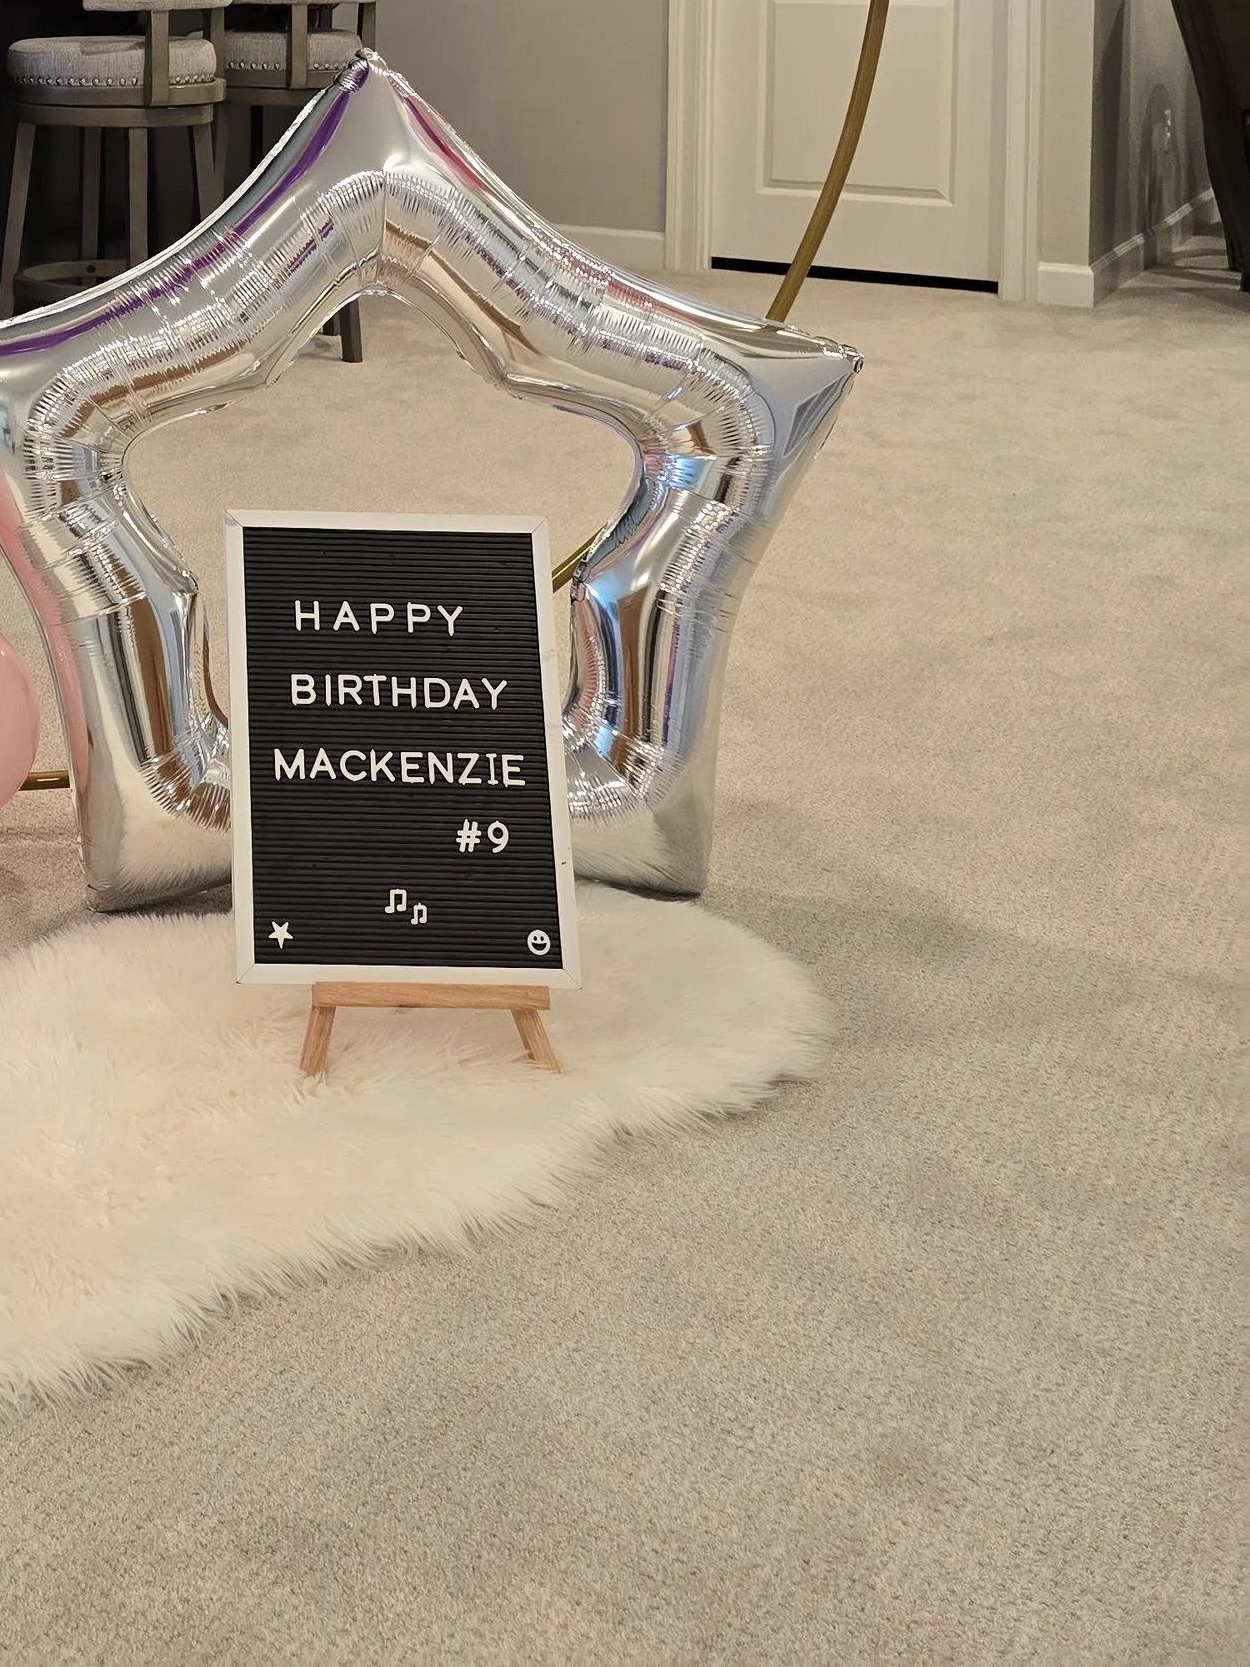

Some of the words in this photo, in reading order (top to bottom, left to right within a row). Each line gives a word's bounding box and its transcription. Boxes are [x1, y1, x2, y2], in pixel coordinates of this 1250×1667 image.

[293, 598, 465, 638] HAPPY
[290, 673, 509, 712] BIRTHDAY
[273, 747, 527, 788] MACKENZIE
[455, 818, 510, 854] #9
